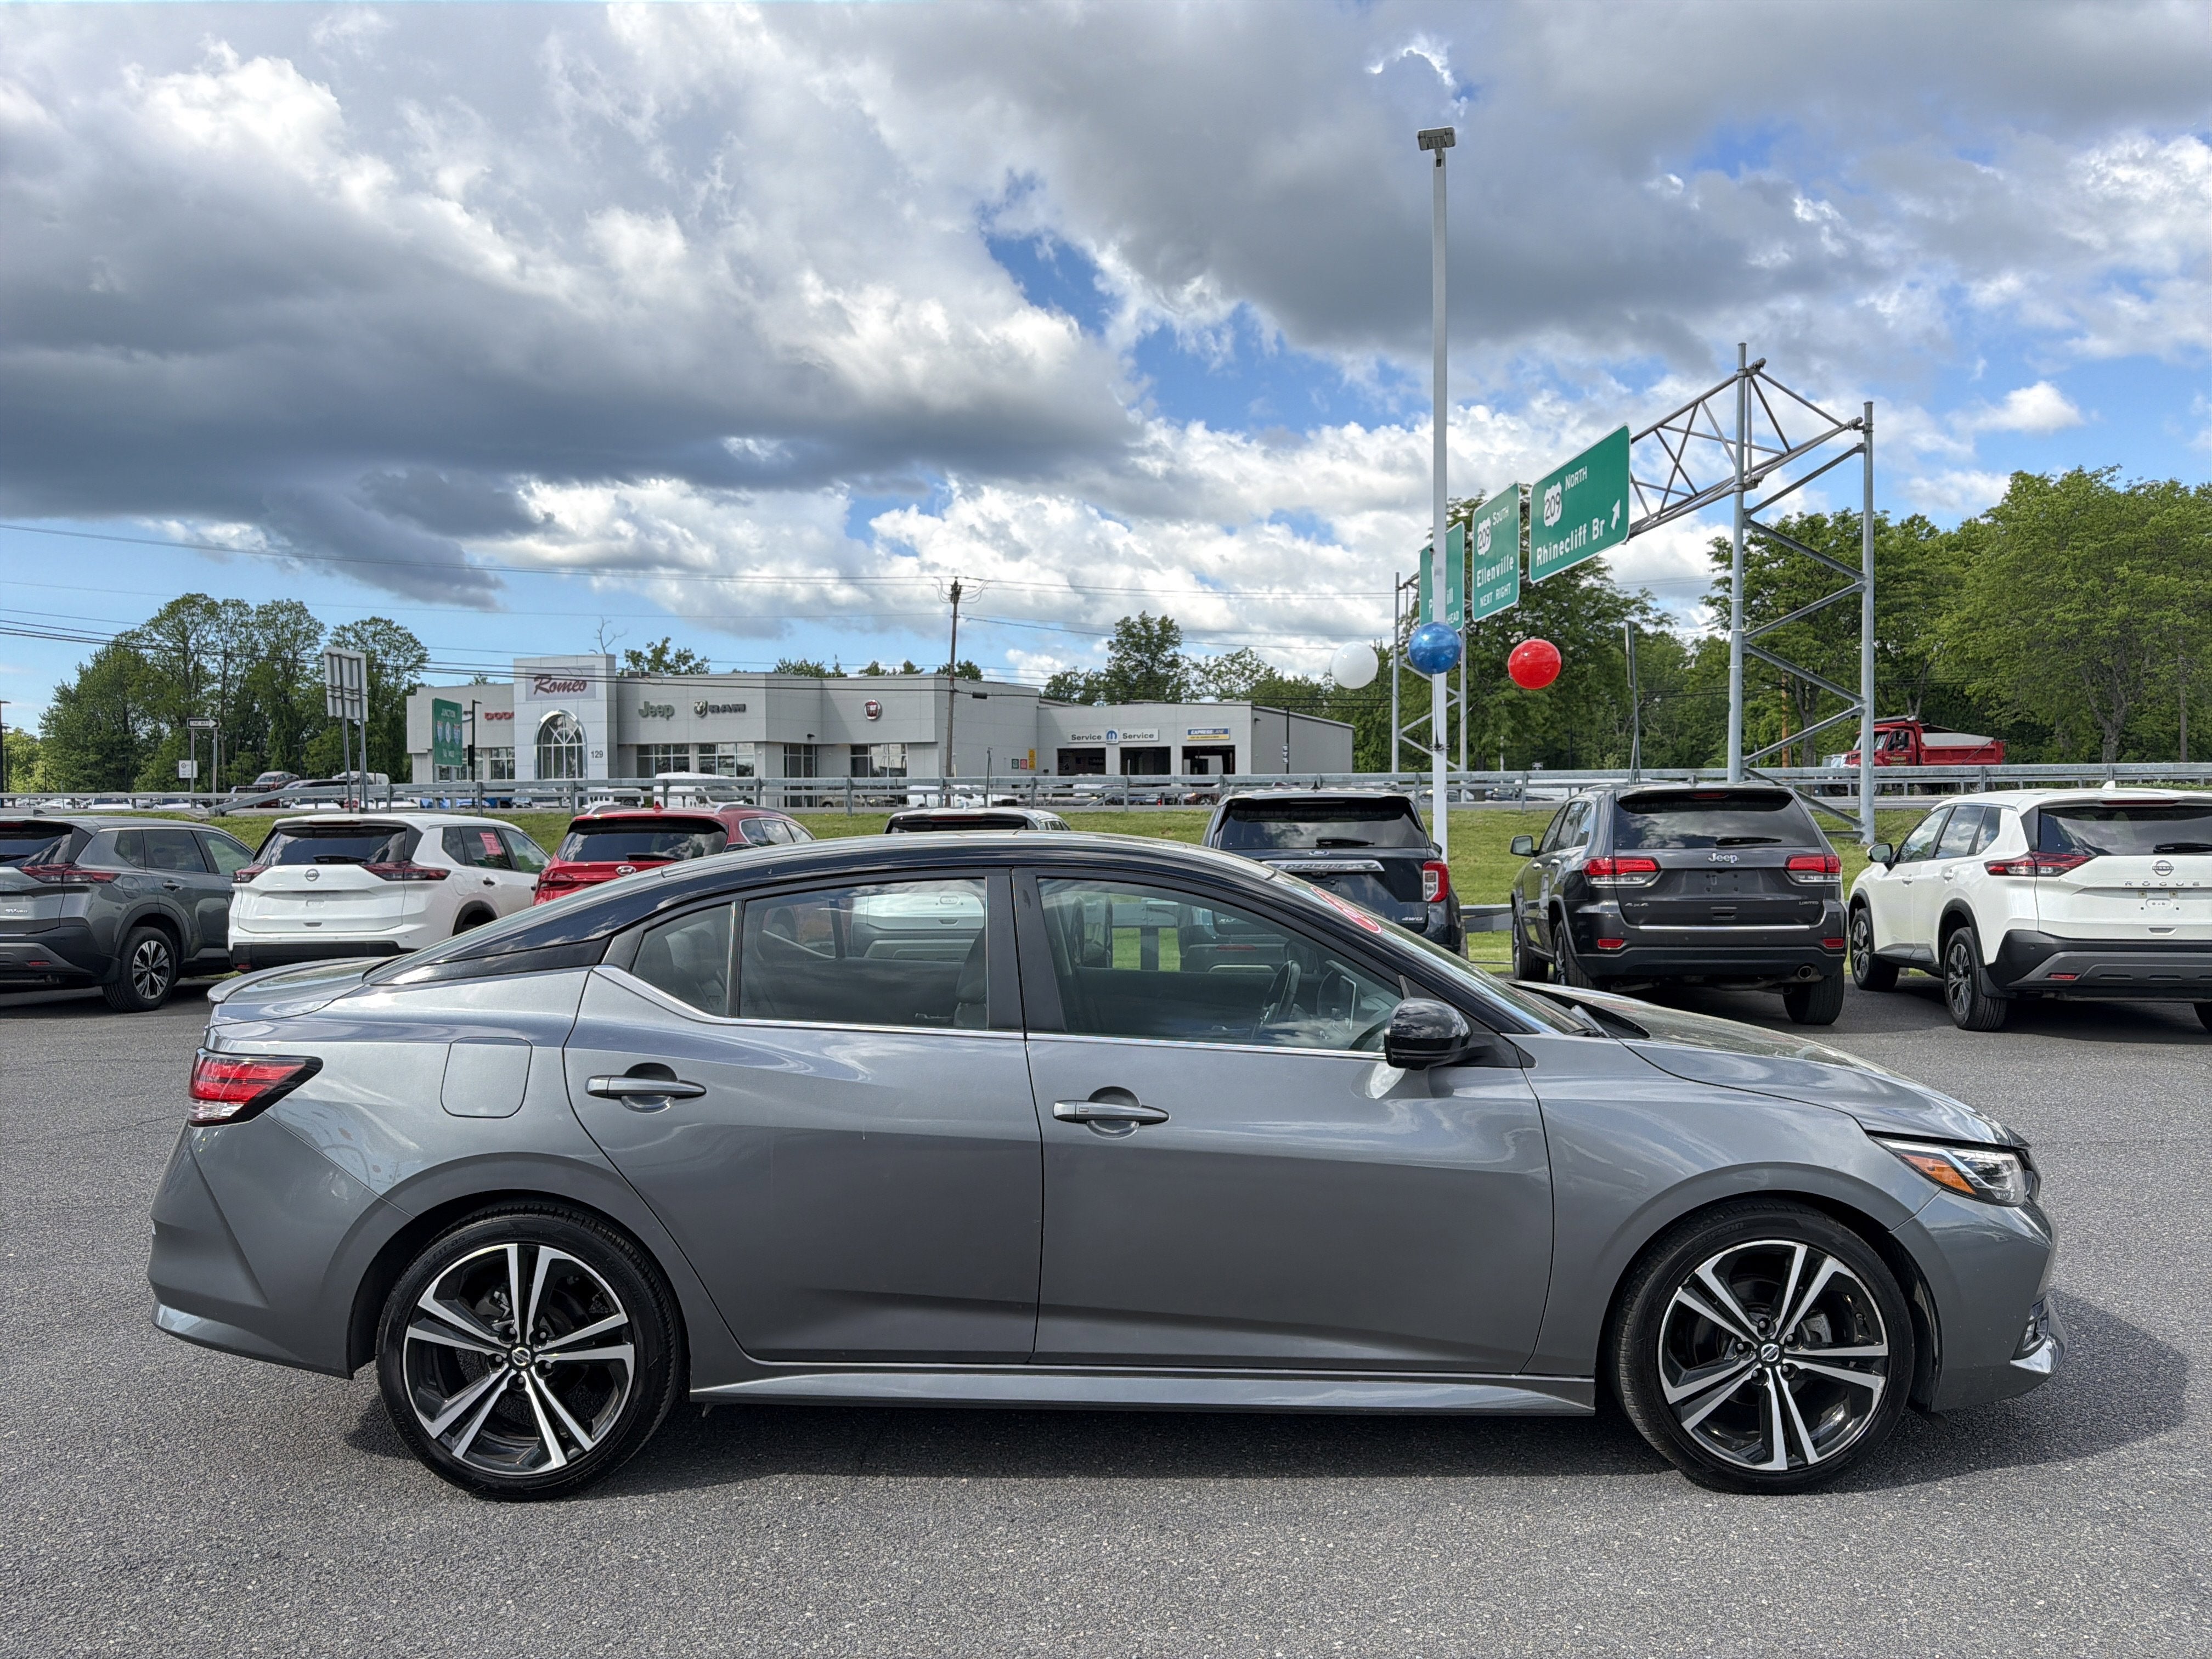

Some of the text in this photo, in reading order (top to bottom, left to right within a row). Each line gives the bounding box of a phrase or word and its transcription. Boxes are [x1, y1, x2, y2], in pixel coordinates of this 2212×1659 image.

[1565, 465, 1588, 491] NORTH
[1492, 505, 1509, 526] SOUTH
[1545, 492, 1560, 521] 209
[1478, 526, 1490, 550] 209
[1536, 517, 1605, 567] Rhinecliff Br
[1476, 554, 1514, 588] Ellenville
[1480, 583, 1511, 608] NEXT RIGHT
[534, 674, 587, 695] Romeo
[638, 701, 675, 720] Jeep
[709, 704, 746, 713] RAM
[591, 749, 603, 758] 129
[1707, 853, 1738, 864] Jeep
